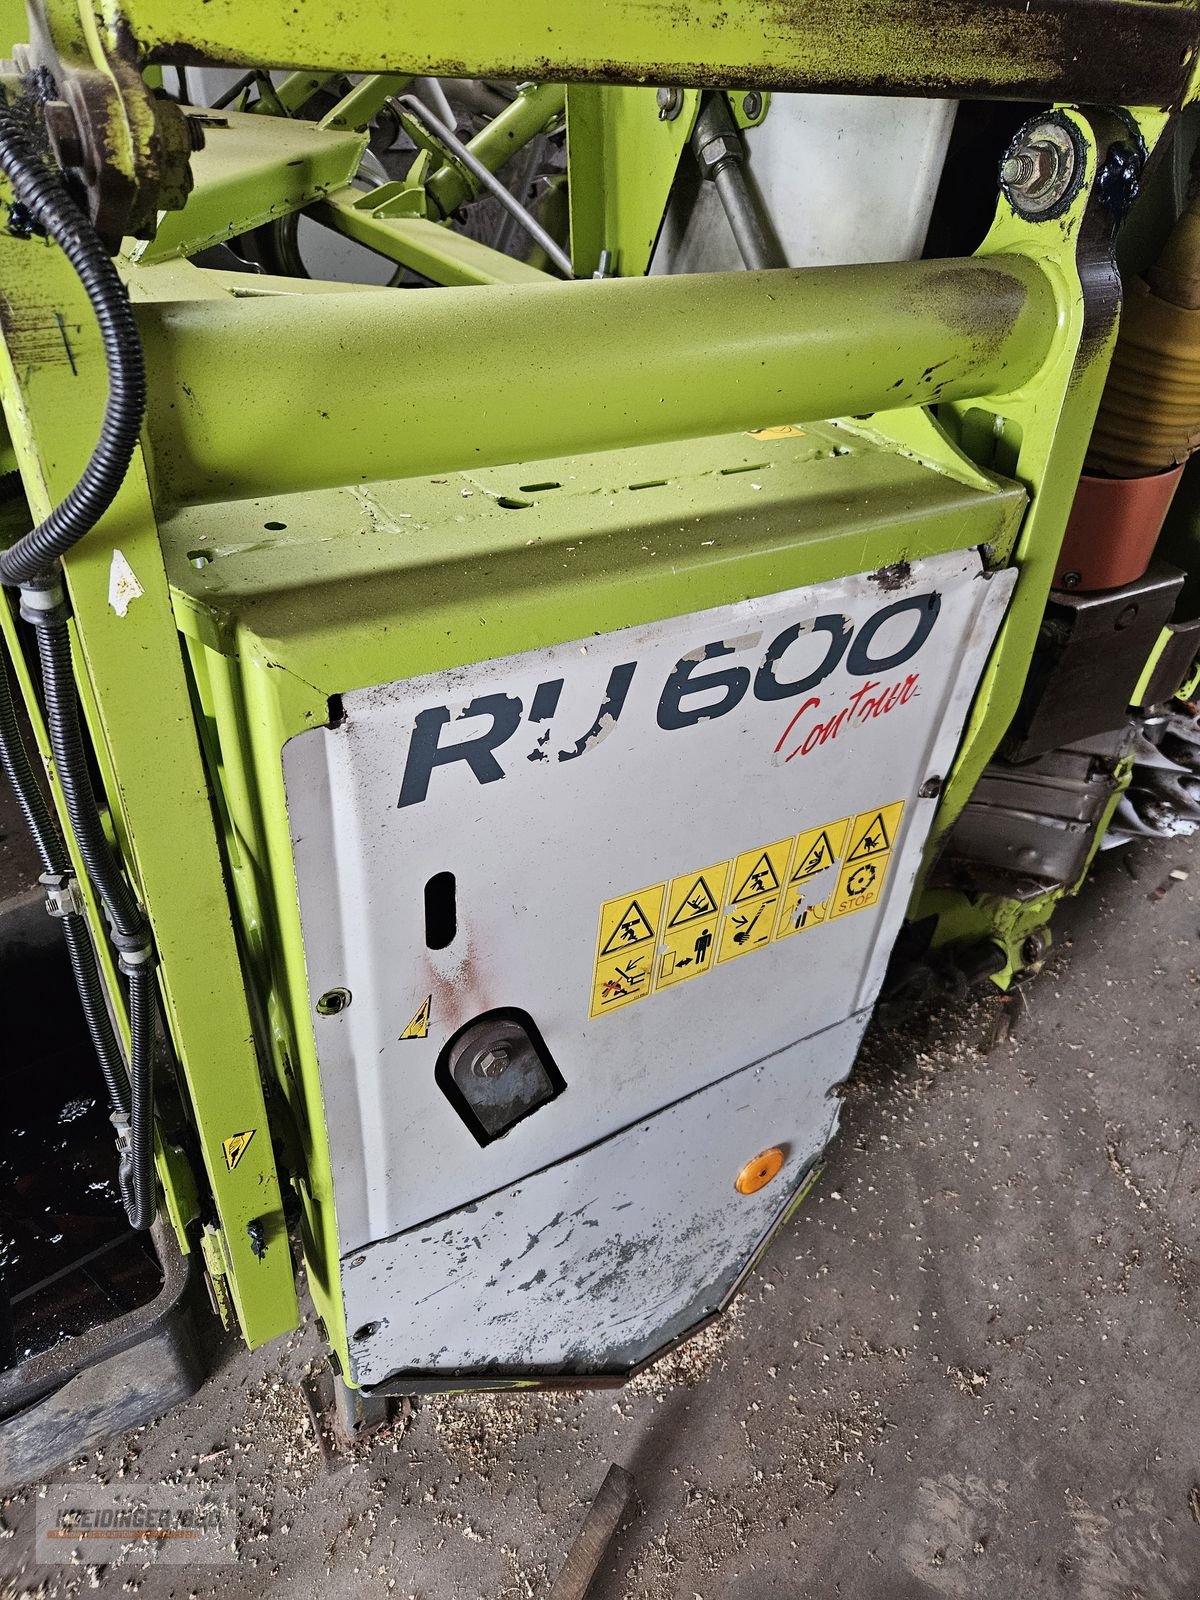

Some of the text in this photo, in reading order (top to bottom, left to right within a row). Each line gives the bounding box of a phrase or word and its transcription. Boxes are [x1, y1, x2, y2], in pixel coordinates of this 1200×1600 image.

[396, 590, 942, 808] RU 600
[772, 673, 920, 766] Contour
[838, 892, 874, 912] STOP
